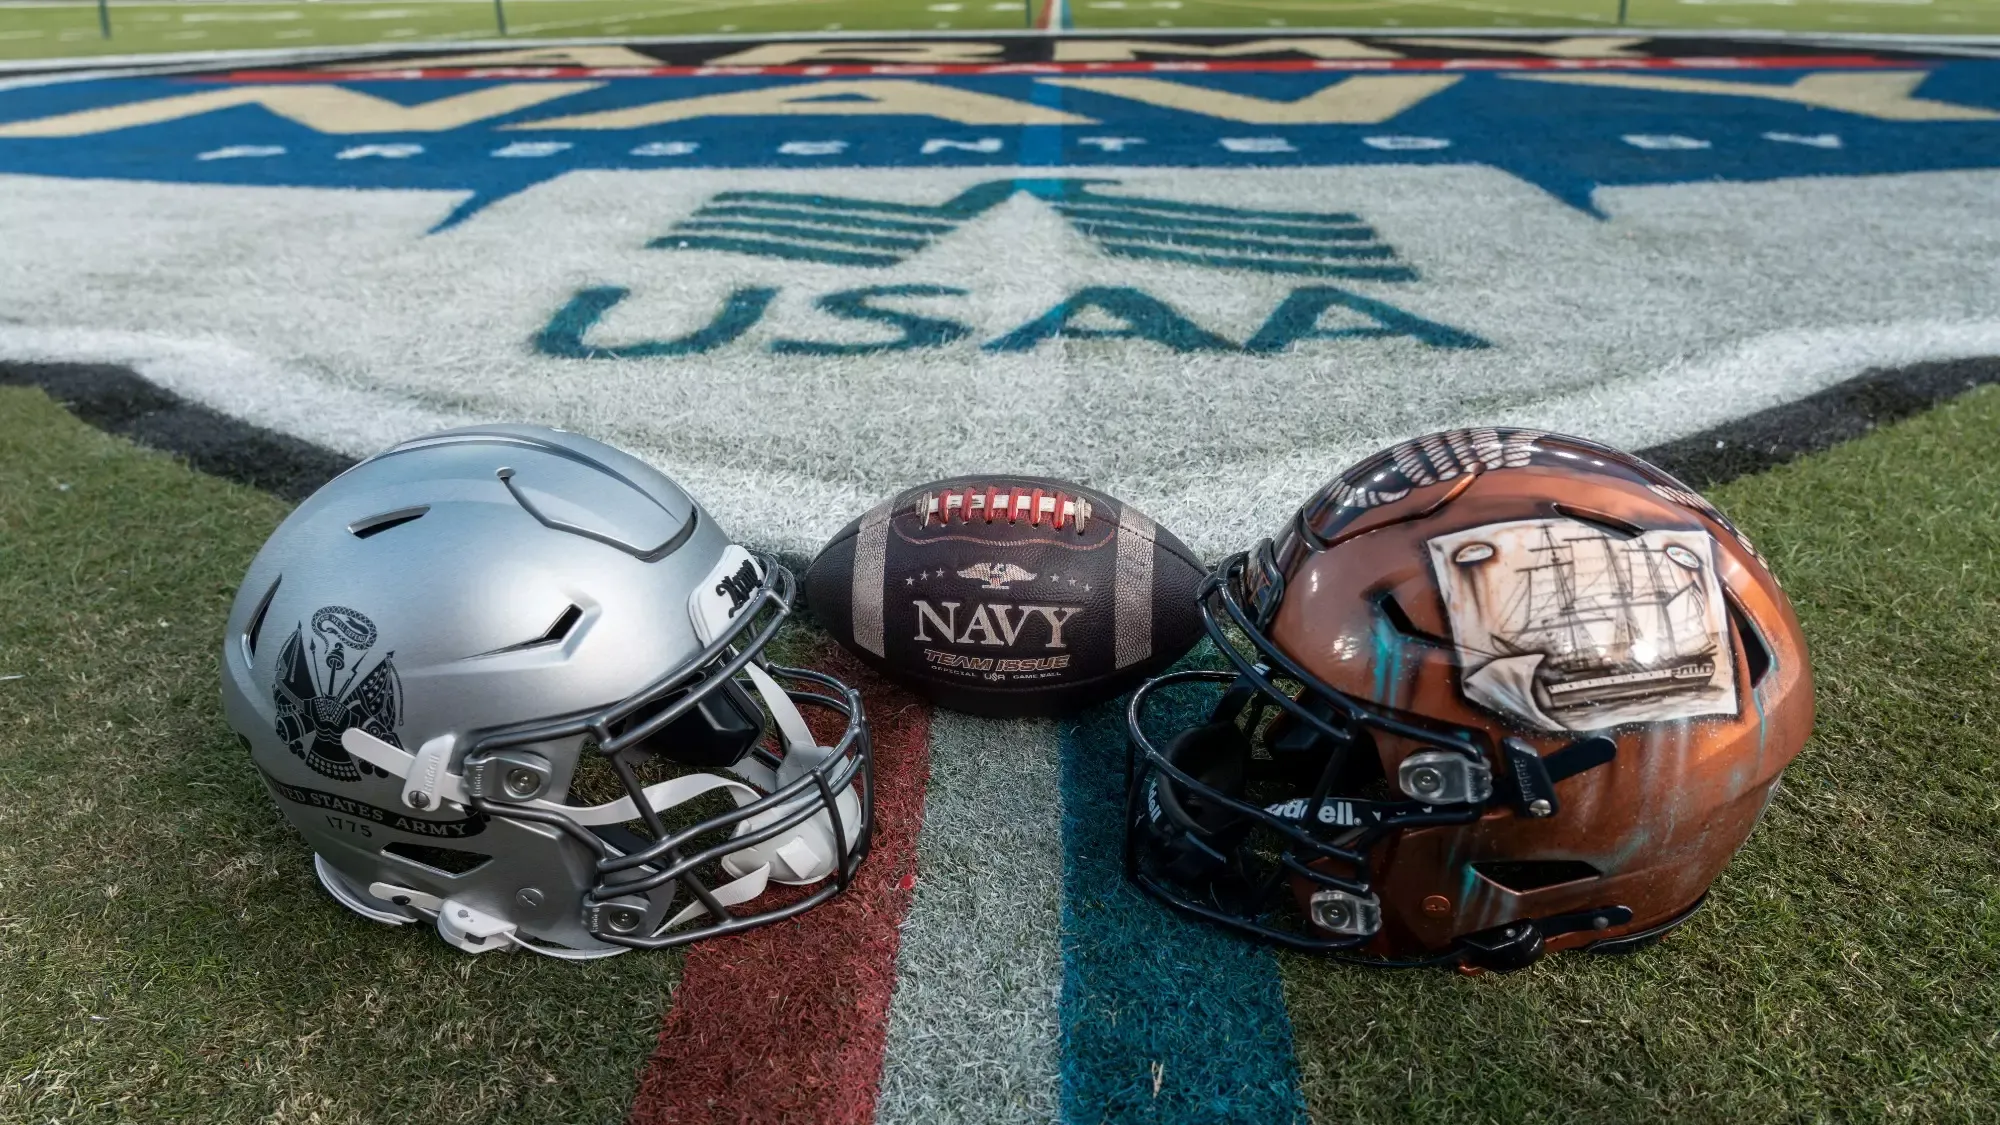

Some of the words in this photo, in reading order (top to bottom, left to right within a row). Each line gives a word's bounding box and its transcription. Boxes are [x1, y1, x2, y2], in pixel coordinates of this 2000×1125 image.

[315, 37, 1653, 70] ARMY
[0, 70, 2000, 134] NAVY
[528, 284, 1494, 359] USAA
[912, 600, 1084, 648] NAVY
[923, 649, 994, 672] TEAM
[996, 655, 1071, 672] ISSUE
[309, 792, 384, 821] STATES
[396, 813, 466, 836] ARMY
[325, 815, 373, 838] 1775
